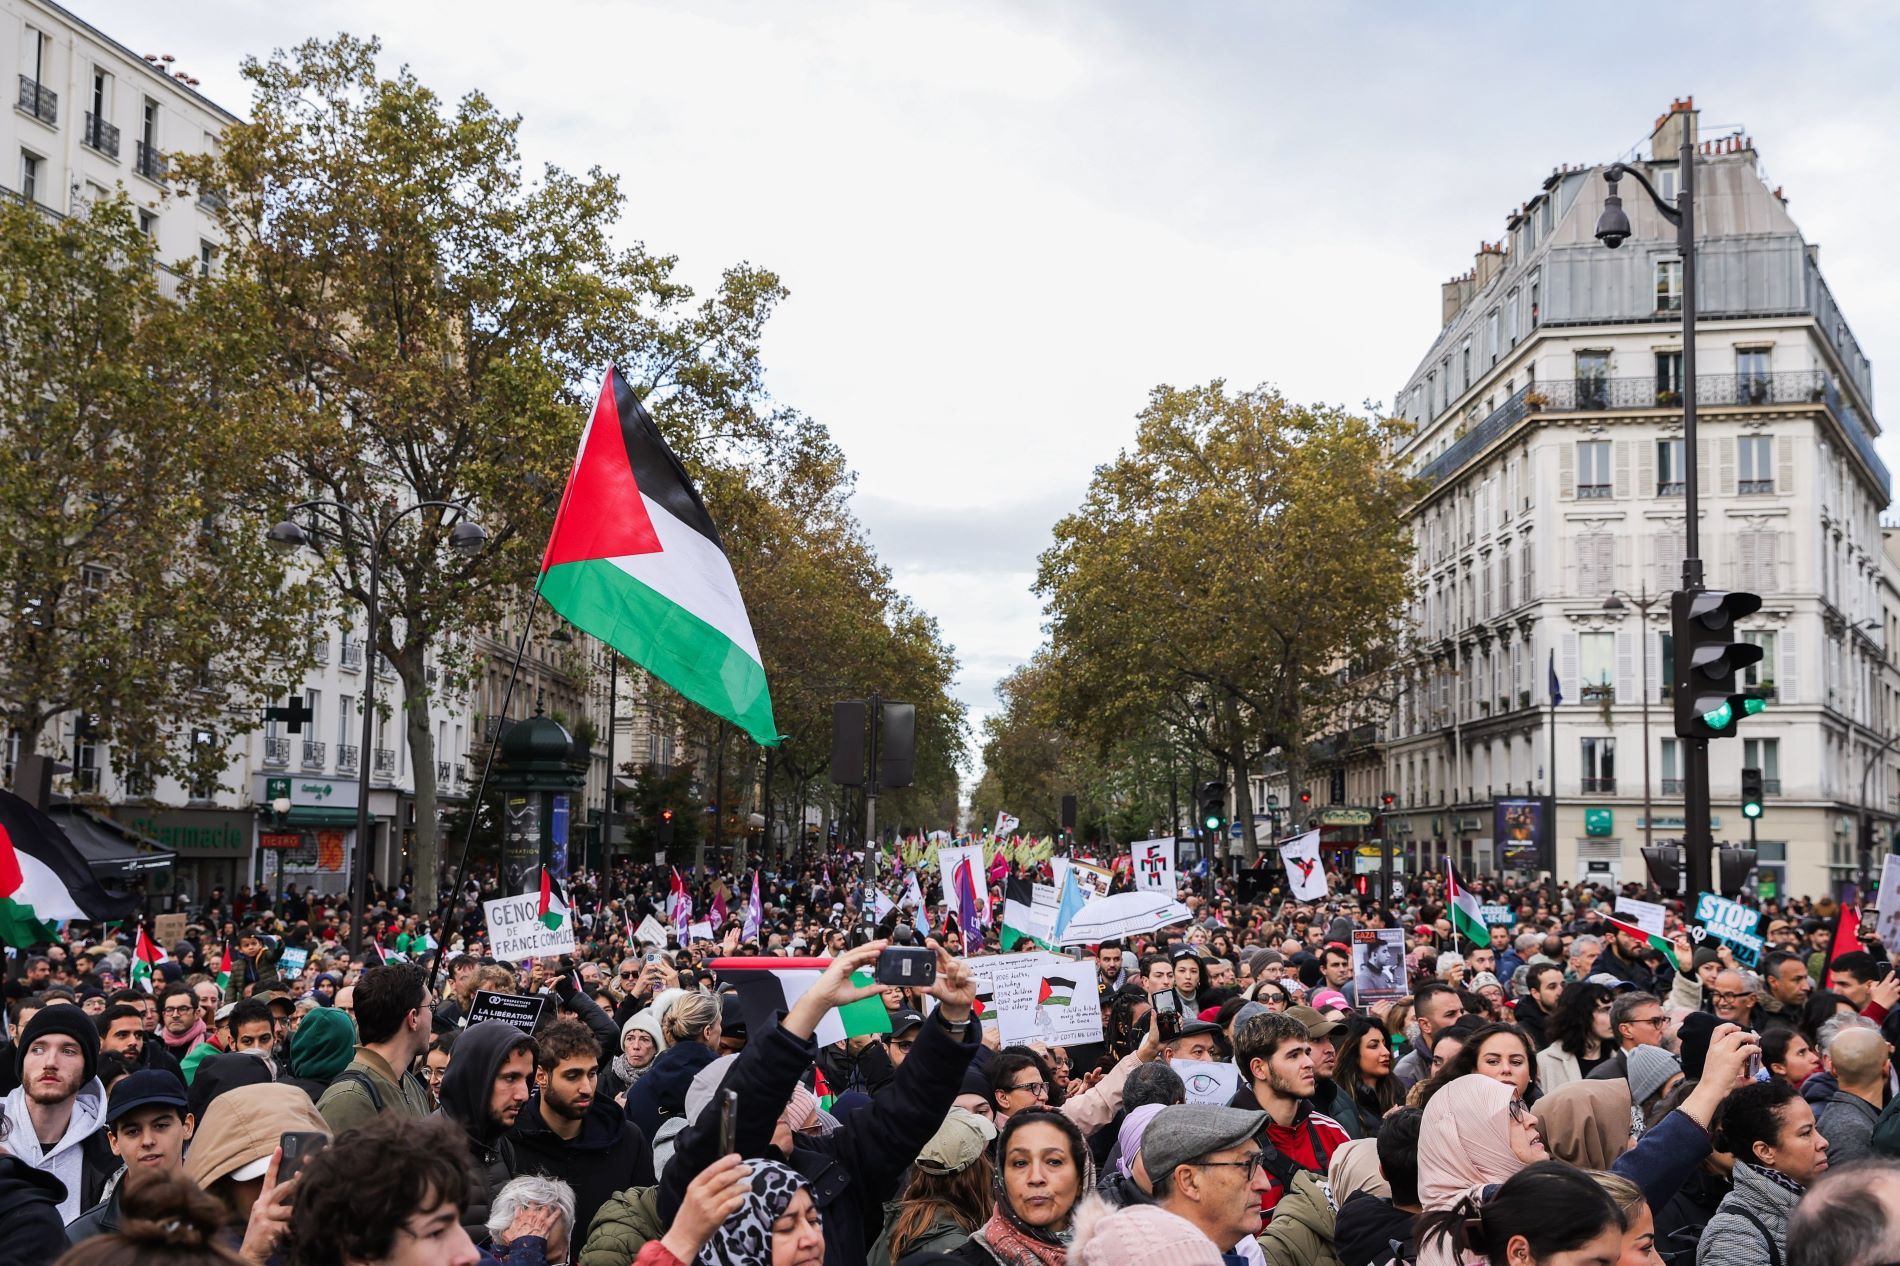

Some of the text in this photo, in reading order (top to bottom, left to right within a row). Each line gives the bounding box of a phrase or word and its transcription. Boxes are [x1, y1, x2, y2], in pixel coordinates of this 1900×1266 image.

[1699, 895, 1758, 932] STOP
[507, 926, 518, 937] DE
[1354, 931, 1376, 939] GAZA
[495, 928, 574, 956] FRANCE COMPLICE
[1725, 939, 1756, 965] GAZA
[490, 1010, 534, 1020] LIBÉRATION
[497, 1018, 535, 1027] ALESTINE
[1008, 1039, 1026, 1047] TIME
[1060, 1031, 1085, 1041] COSTING
